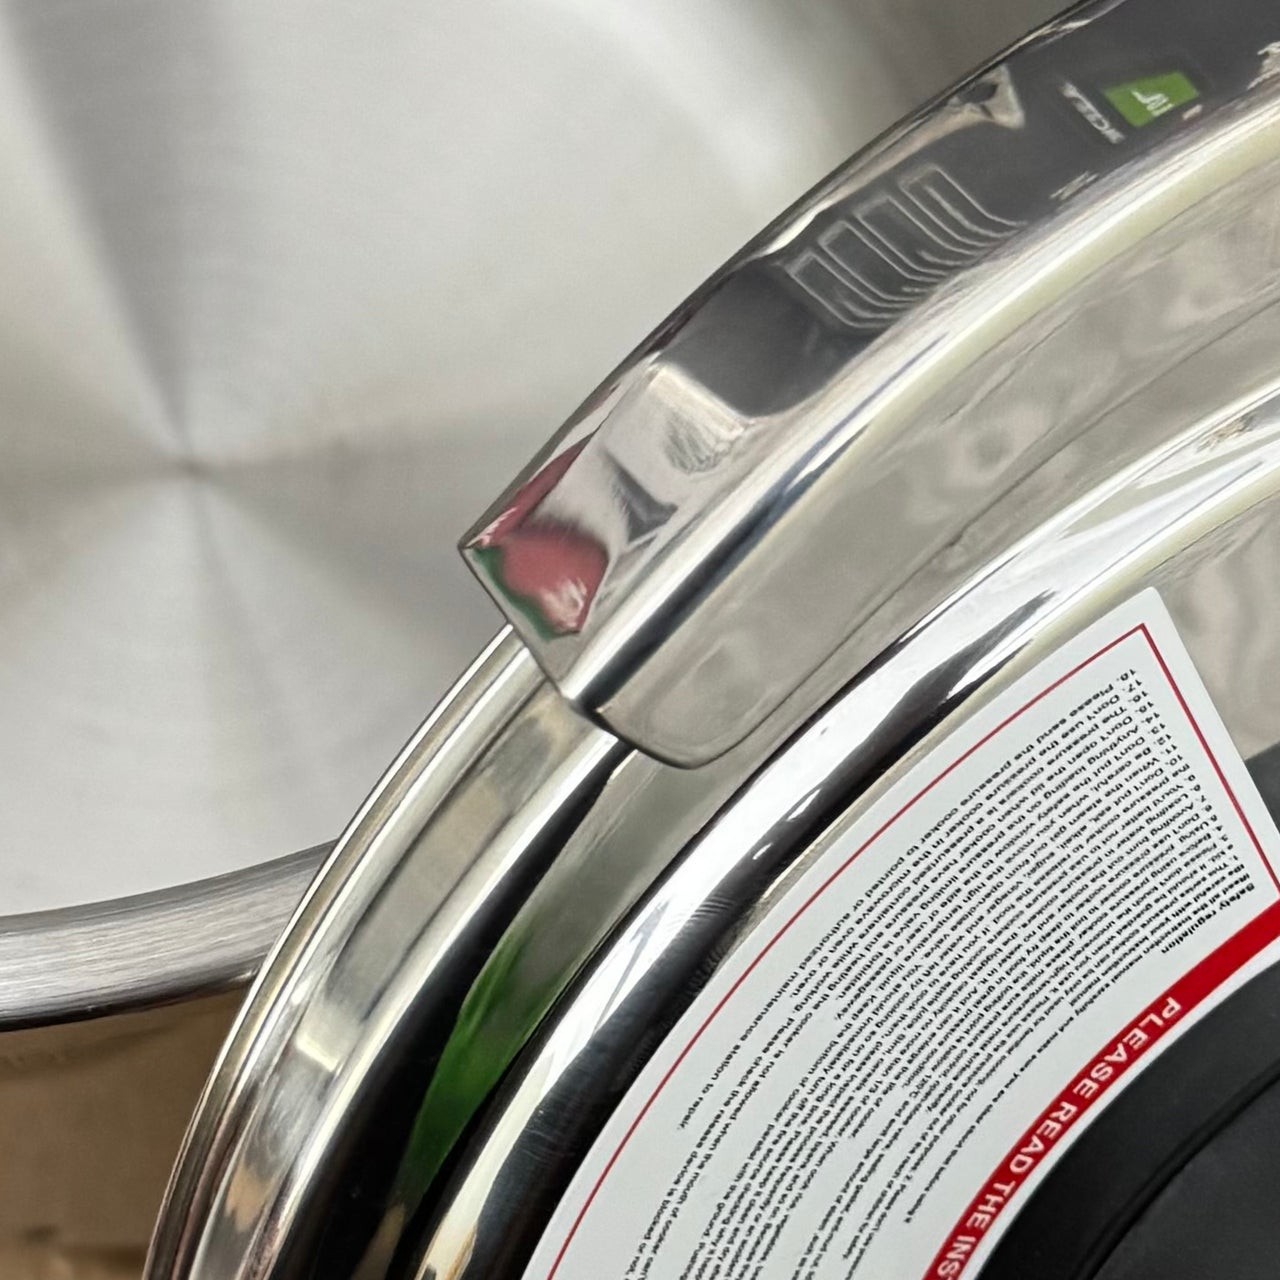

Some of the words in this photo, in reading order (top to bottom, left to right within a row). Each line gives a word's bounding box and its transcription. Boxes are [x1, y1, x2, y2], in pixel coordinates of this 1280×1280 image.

[1216, 880, 1256, 912] Safety
[1159, 907, 1218, 955] regulation
[1072, 996, 1183, 1099] PLEASE
[1008, 1101, 1077, 1175] READ
[965, 1177, 1018, 1231] THE
